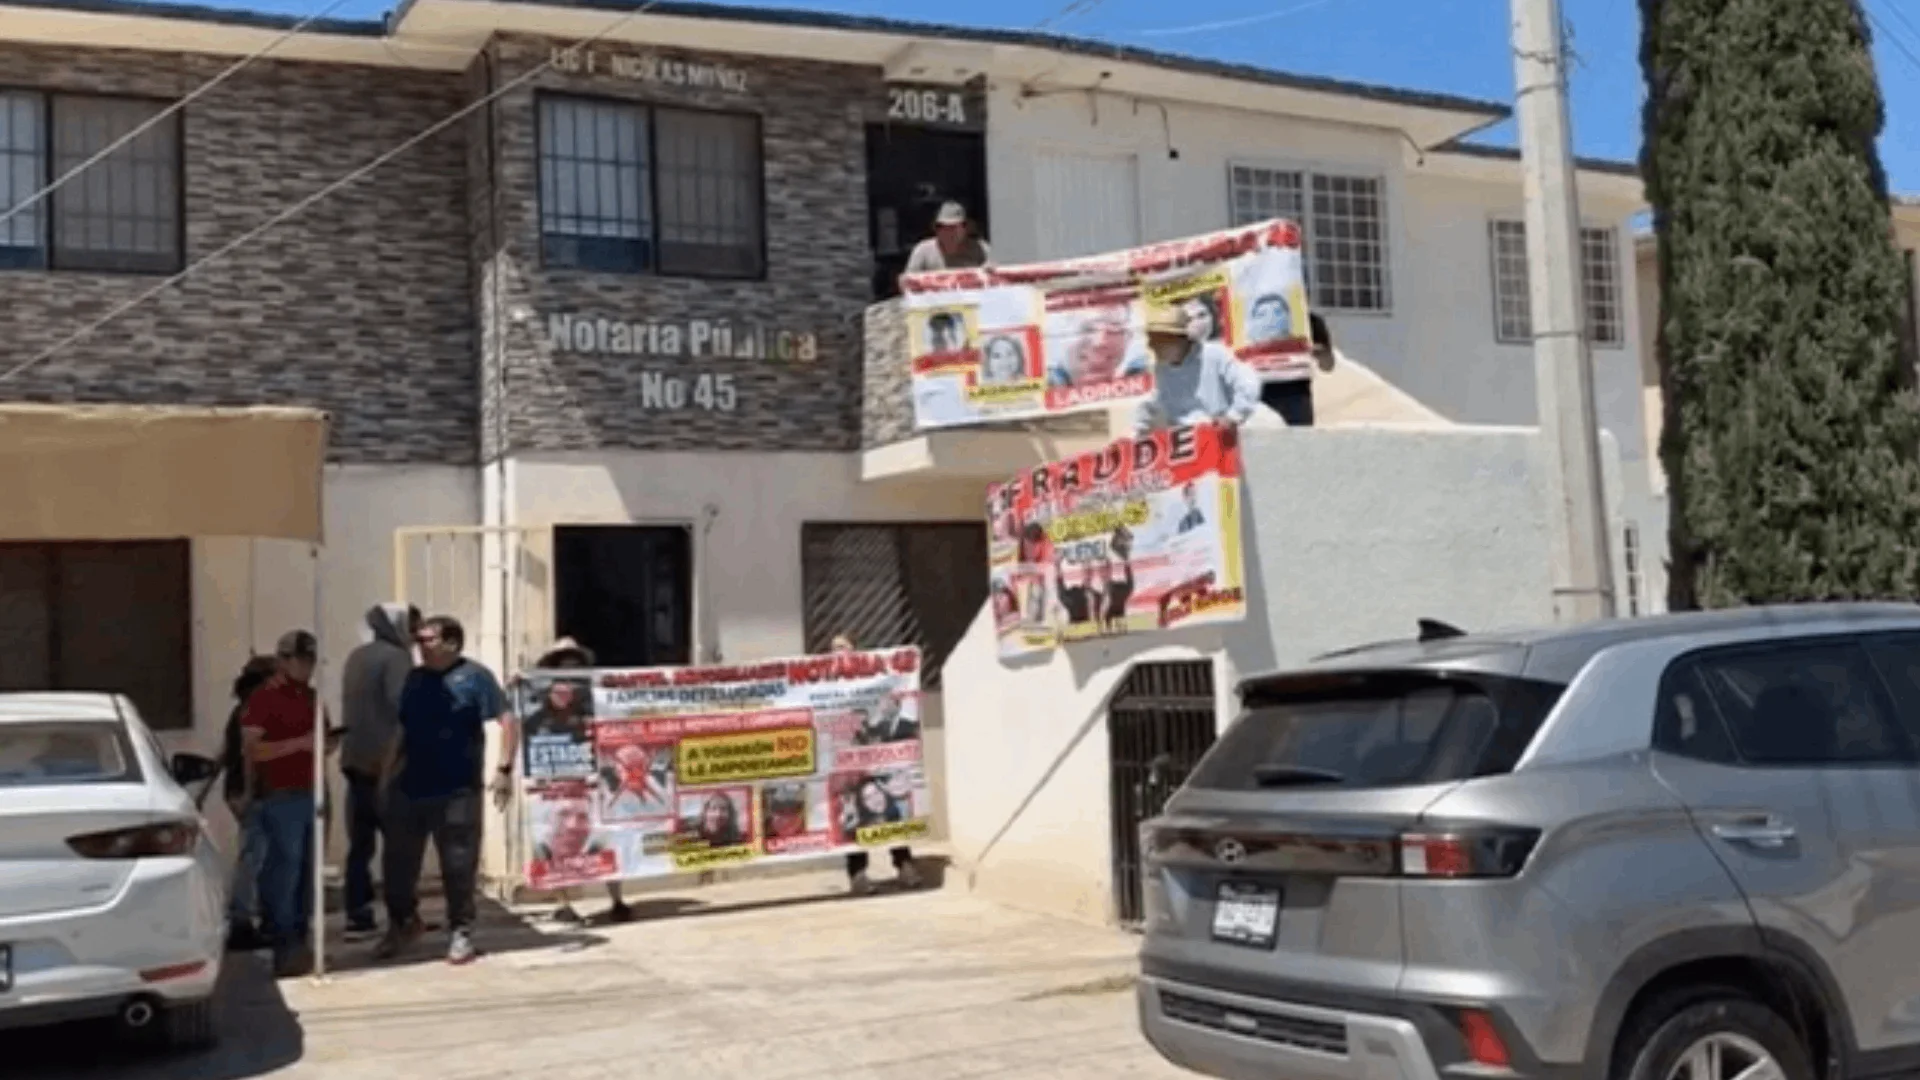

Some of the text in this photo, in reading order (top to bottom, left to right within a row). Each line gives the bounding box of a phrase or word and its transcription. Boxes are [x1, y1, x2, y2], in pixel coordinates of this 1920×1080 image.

[888, 87, 966, 123] 206-A
[641, 370, 736, 411] No 45
[1001, 427, 1195, 508] FRAUDE
[776, 735, 809, 752] NO
[687, 764, 705, 777] LE
